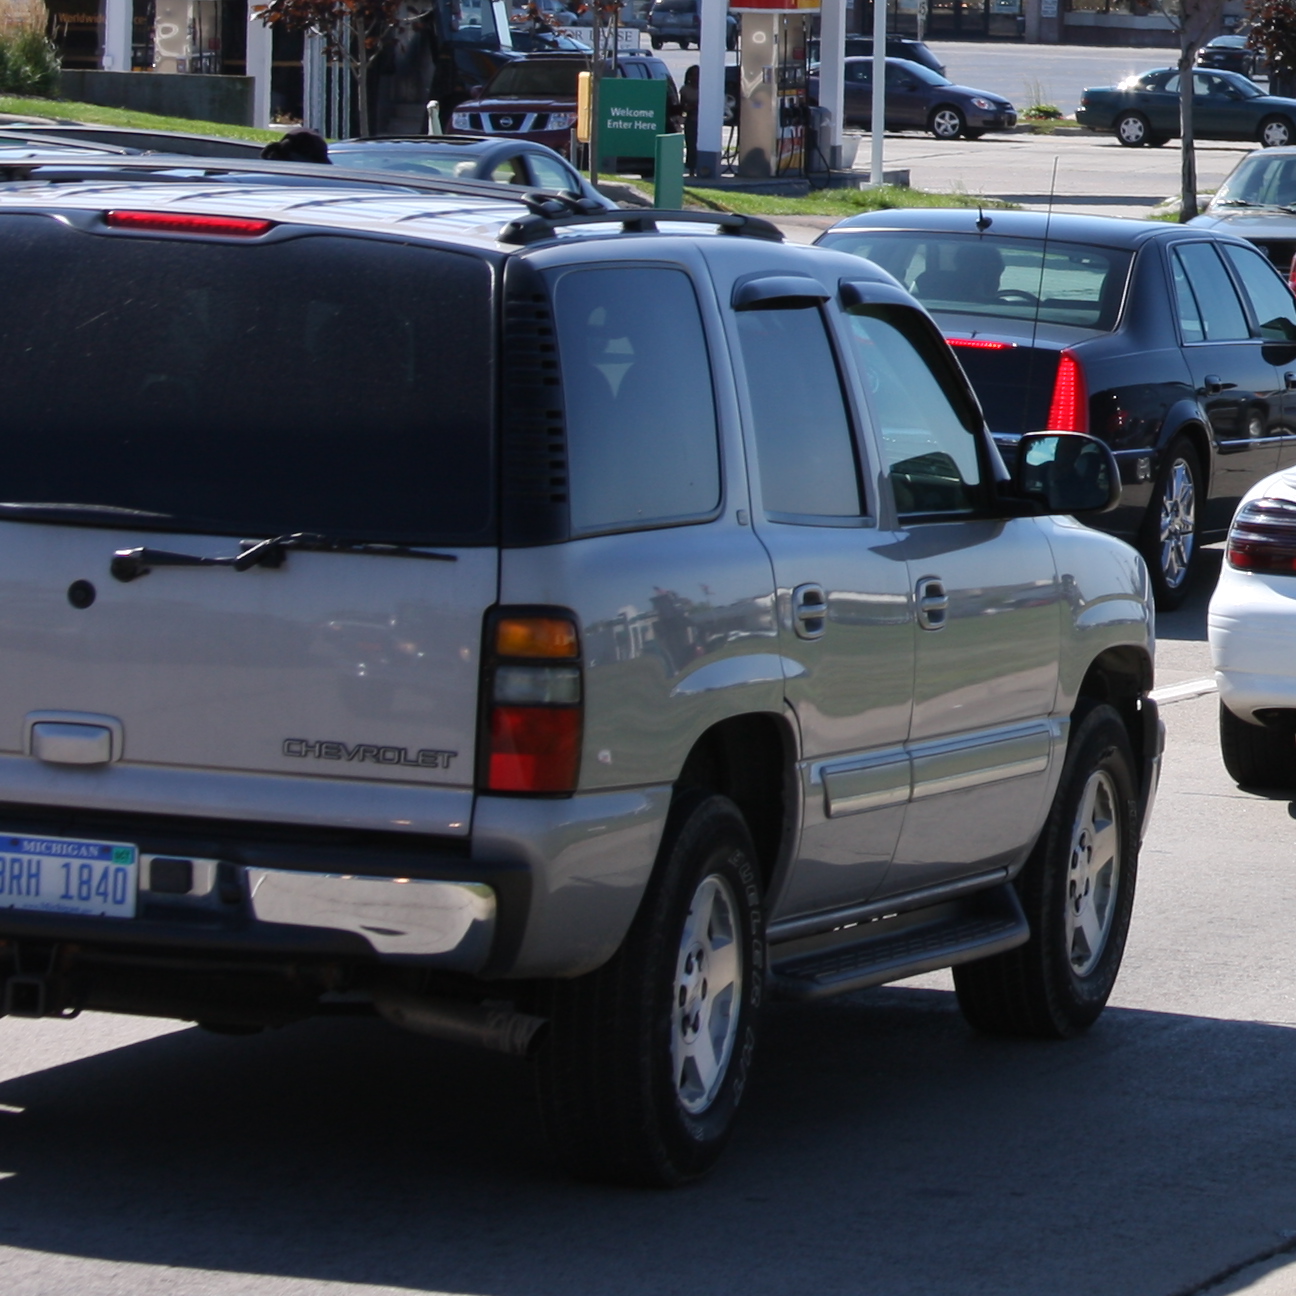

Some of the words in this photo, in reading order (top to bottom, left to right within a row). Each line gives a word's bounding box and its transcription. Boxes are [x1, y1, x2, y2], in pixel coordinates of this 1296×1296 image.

[610, 107, 655, 118] Welcome
[607, 119, 632, 129] Enter
[634, 120, 657, 130] Here
[282, 738, 459, 770] CHEVROLET
[22, 839, 100, 858] MICHIGAN
[60, 861, 128, 905] 1840
